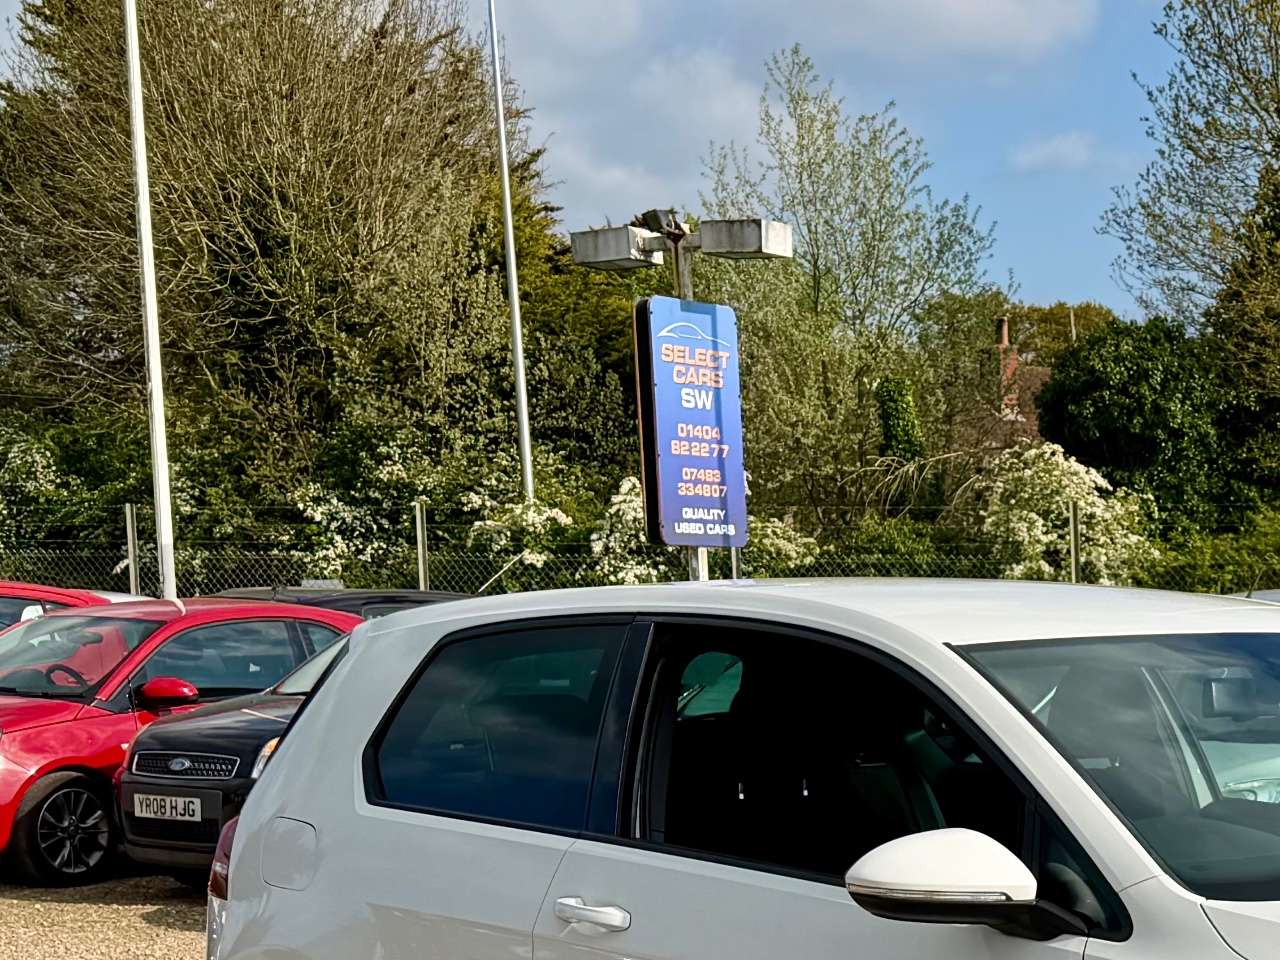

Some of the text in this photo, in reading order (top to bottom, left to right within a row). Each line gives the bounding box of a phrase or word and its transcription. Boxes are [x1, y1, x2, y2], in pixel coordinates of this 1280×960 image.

[661, 343, 730, 369] SELECT
[673, 365, 724, 388] CARS
[681, 387, 714, 410] SW
[677, 423, 721, 440] 01404
[682, 507, 726, 520] QUALITY
[674, 522, 736, 536] USED CARS
[138, 796, 196, 818] YR08 HJG
